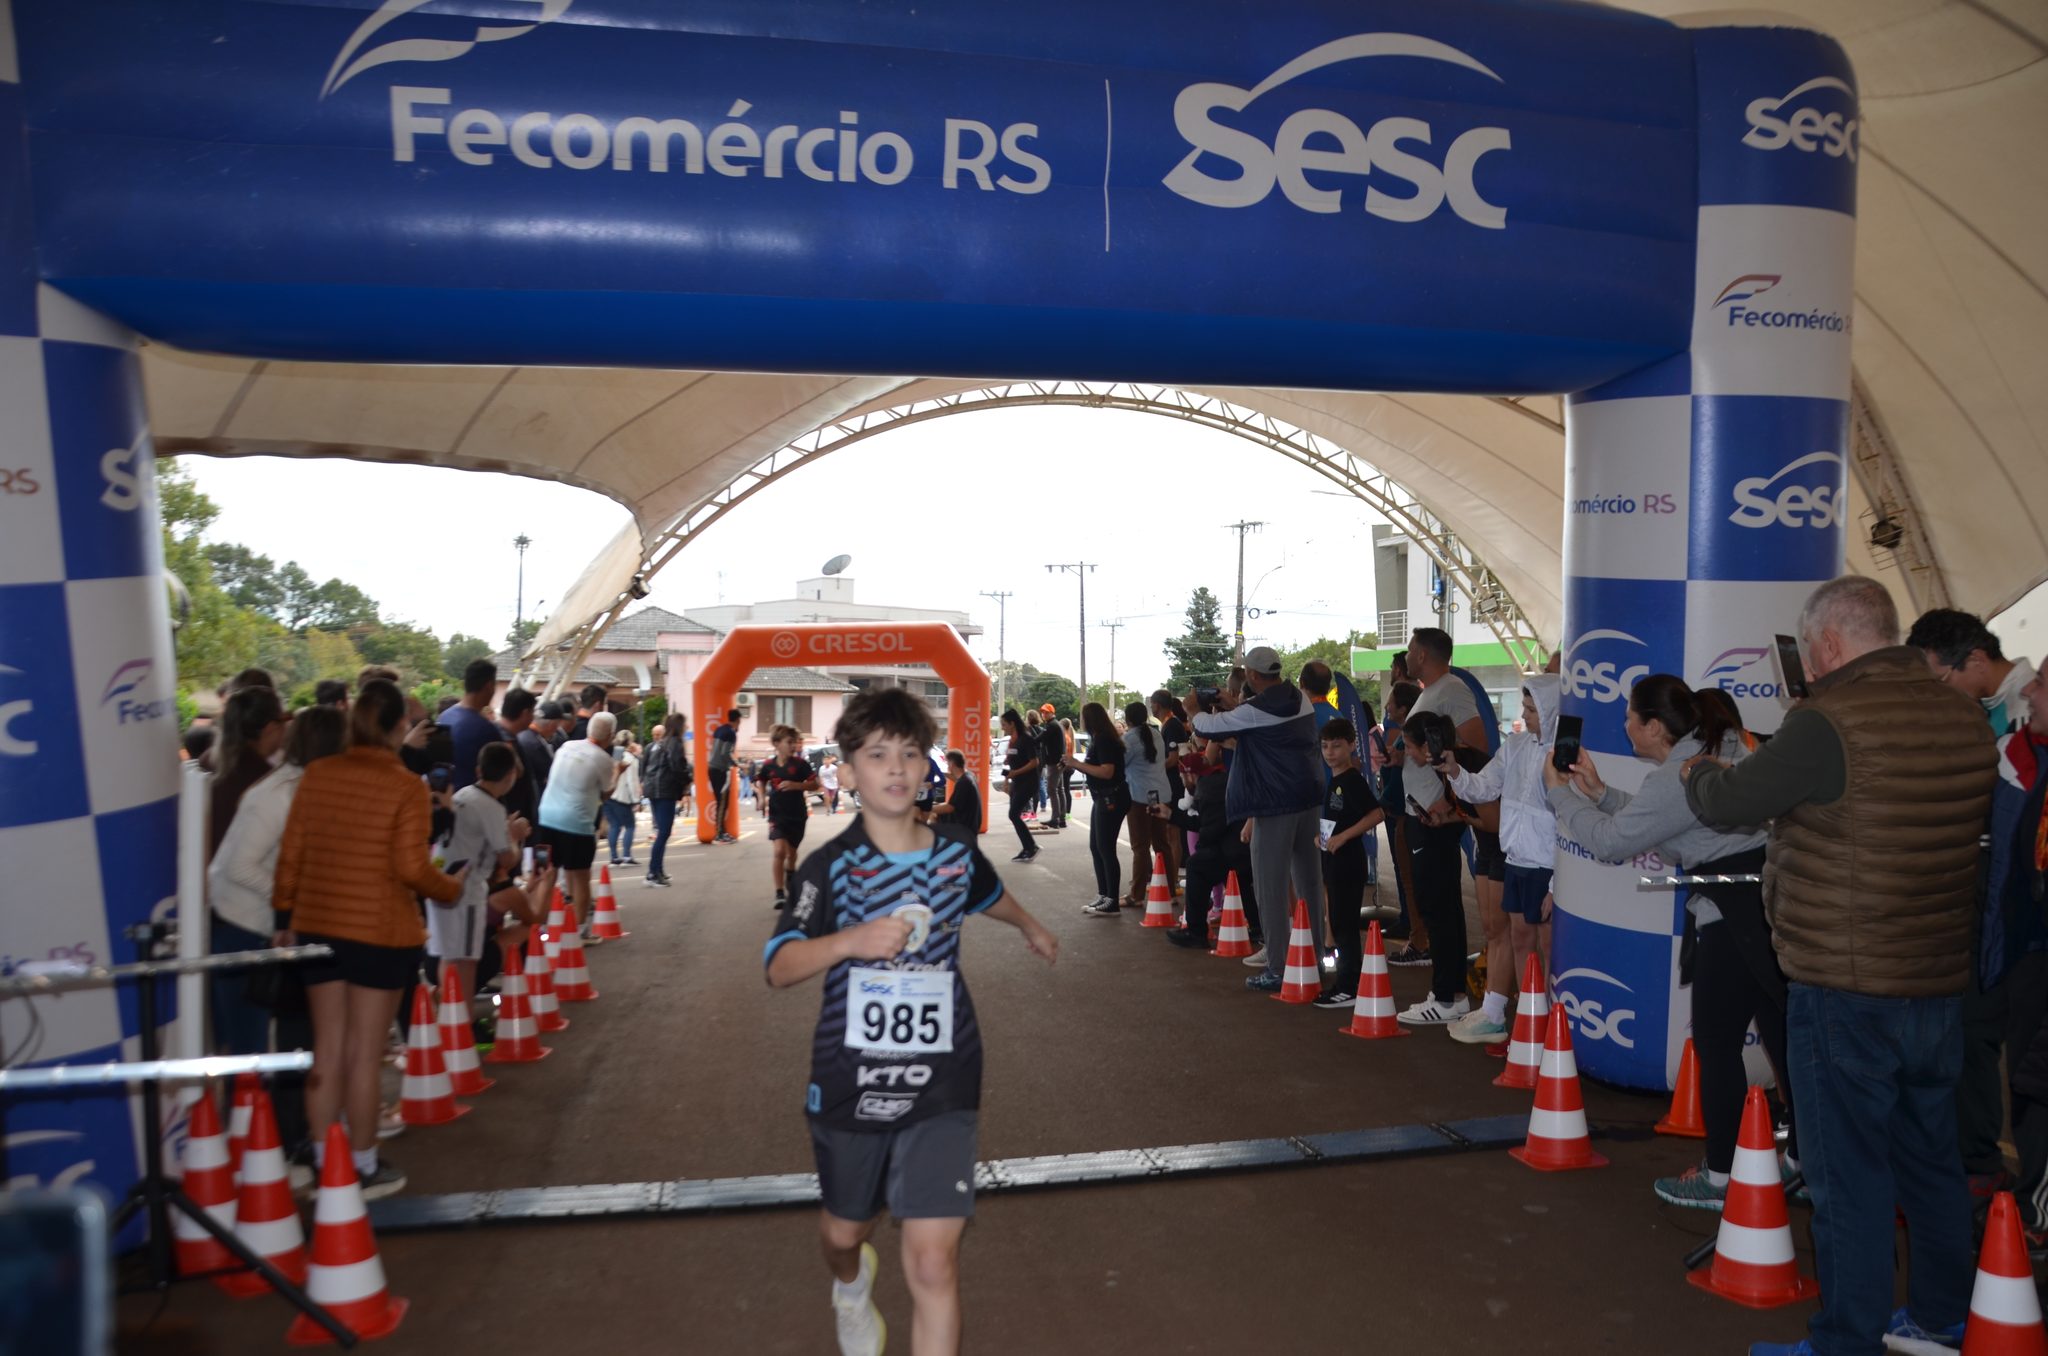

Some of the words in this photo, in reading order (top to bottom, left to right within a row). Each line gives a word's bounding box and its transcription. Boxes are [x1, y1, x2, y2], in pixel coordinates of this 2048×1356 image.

[390, 86, 914, 185] Fecomércio
[942, 118, 1052, 194] RS
[1161, 82, 1512, 230] Sesc
[1728, 306, 1843, 332] Fecomércio
[1643, 494, 1676, 514] RS
[808, 632, 913, 654] CRESOL
[964, 701, 981, 784] RESOL
[863, 1002, 939, 1044] 985
[856, 1064, 932, 1087] KTO
